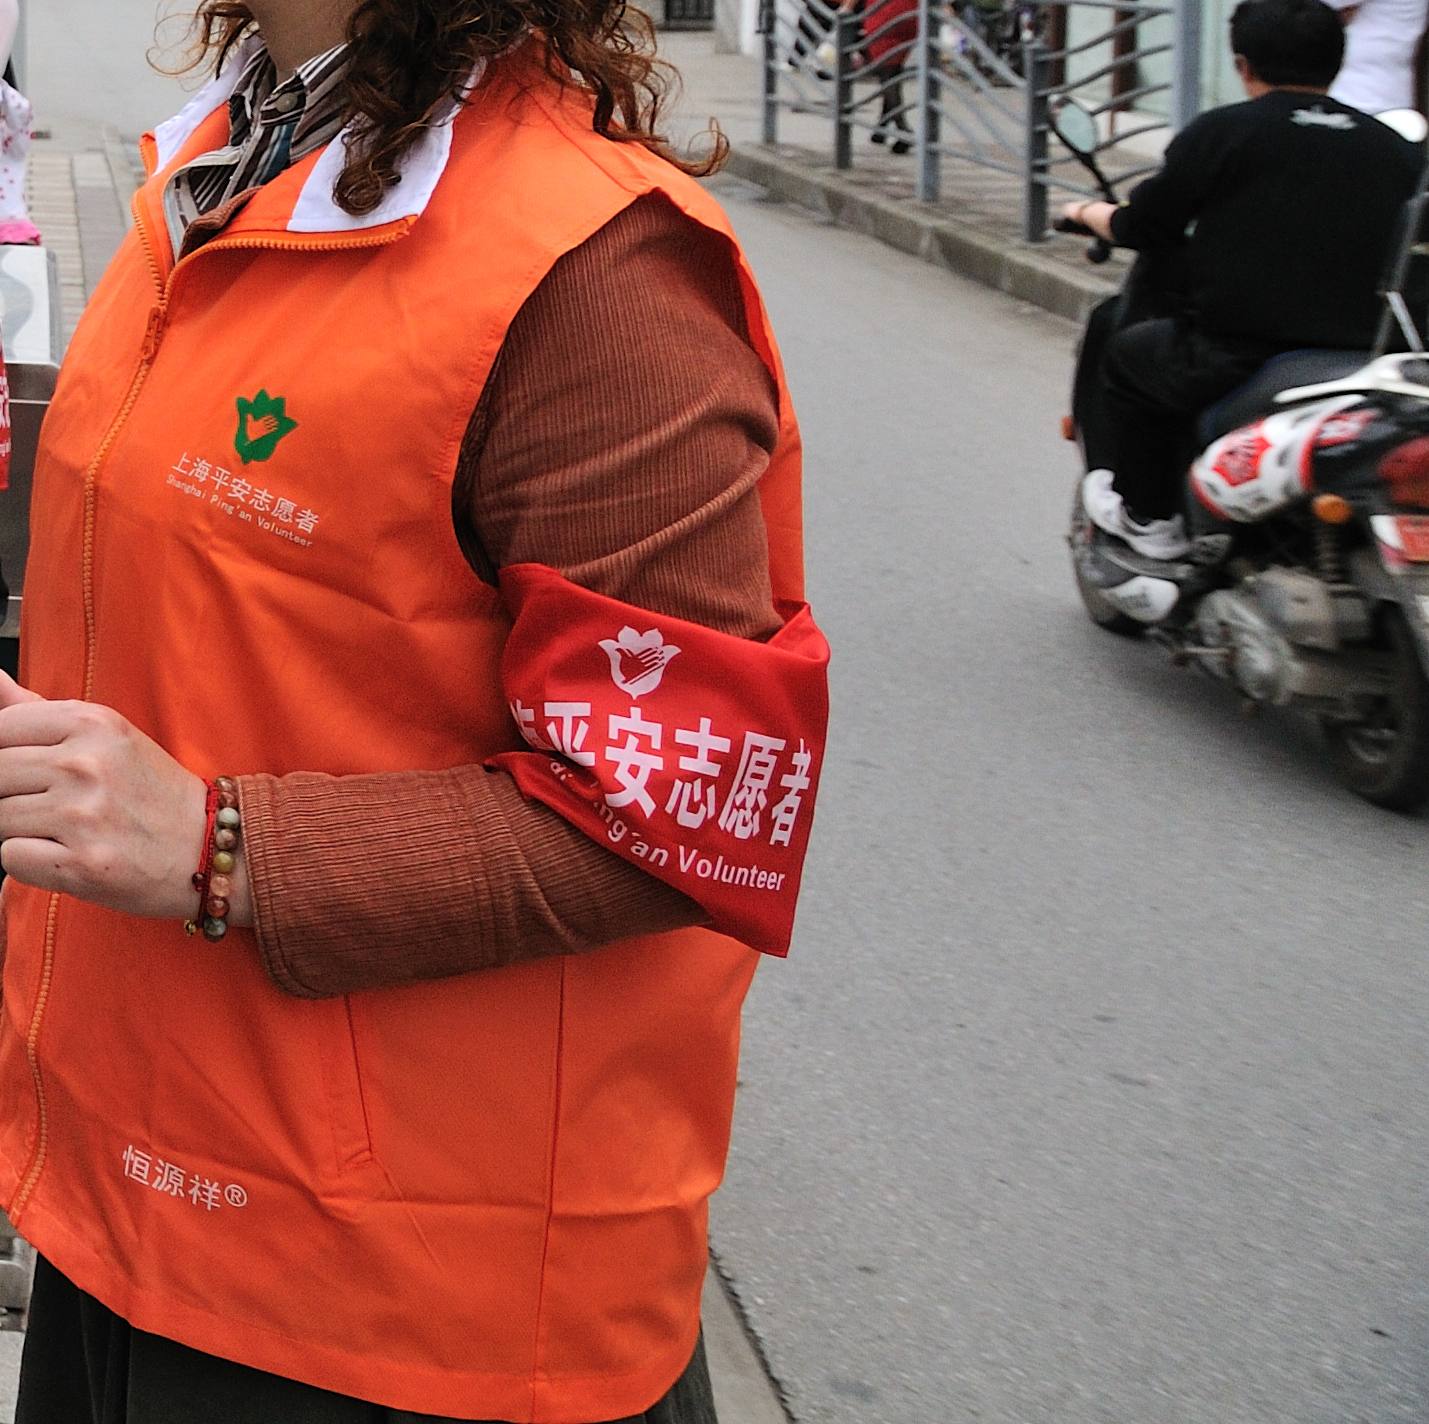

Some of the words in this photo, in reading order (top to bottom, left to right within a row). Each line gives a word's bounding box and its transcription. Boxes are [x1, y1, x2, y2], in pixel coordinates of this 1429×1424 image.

[166, 474, 207, 499] Shanghai
[257, 515, 313, 548] Volunteer
[171, 451, 320, 535] 上海平安志愿者
[677, 844, 786, 892] Volunteer
